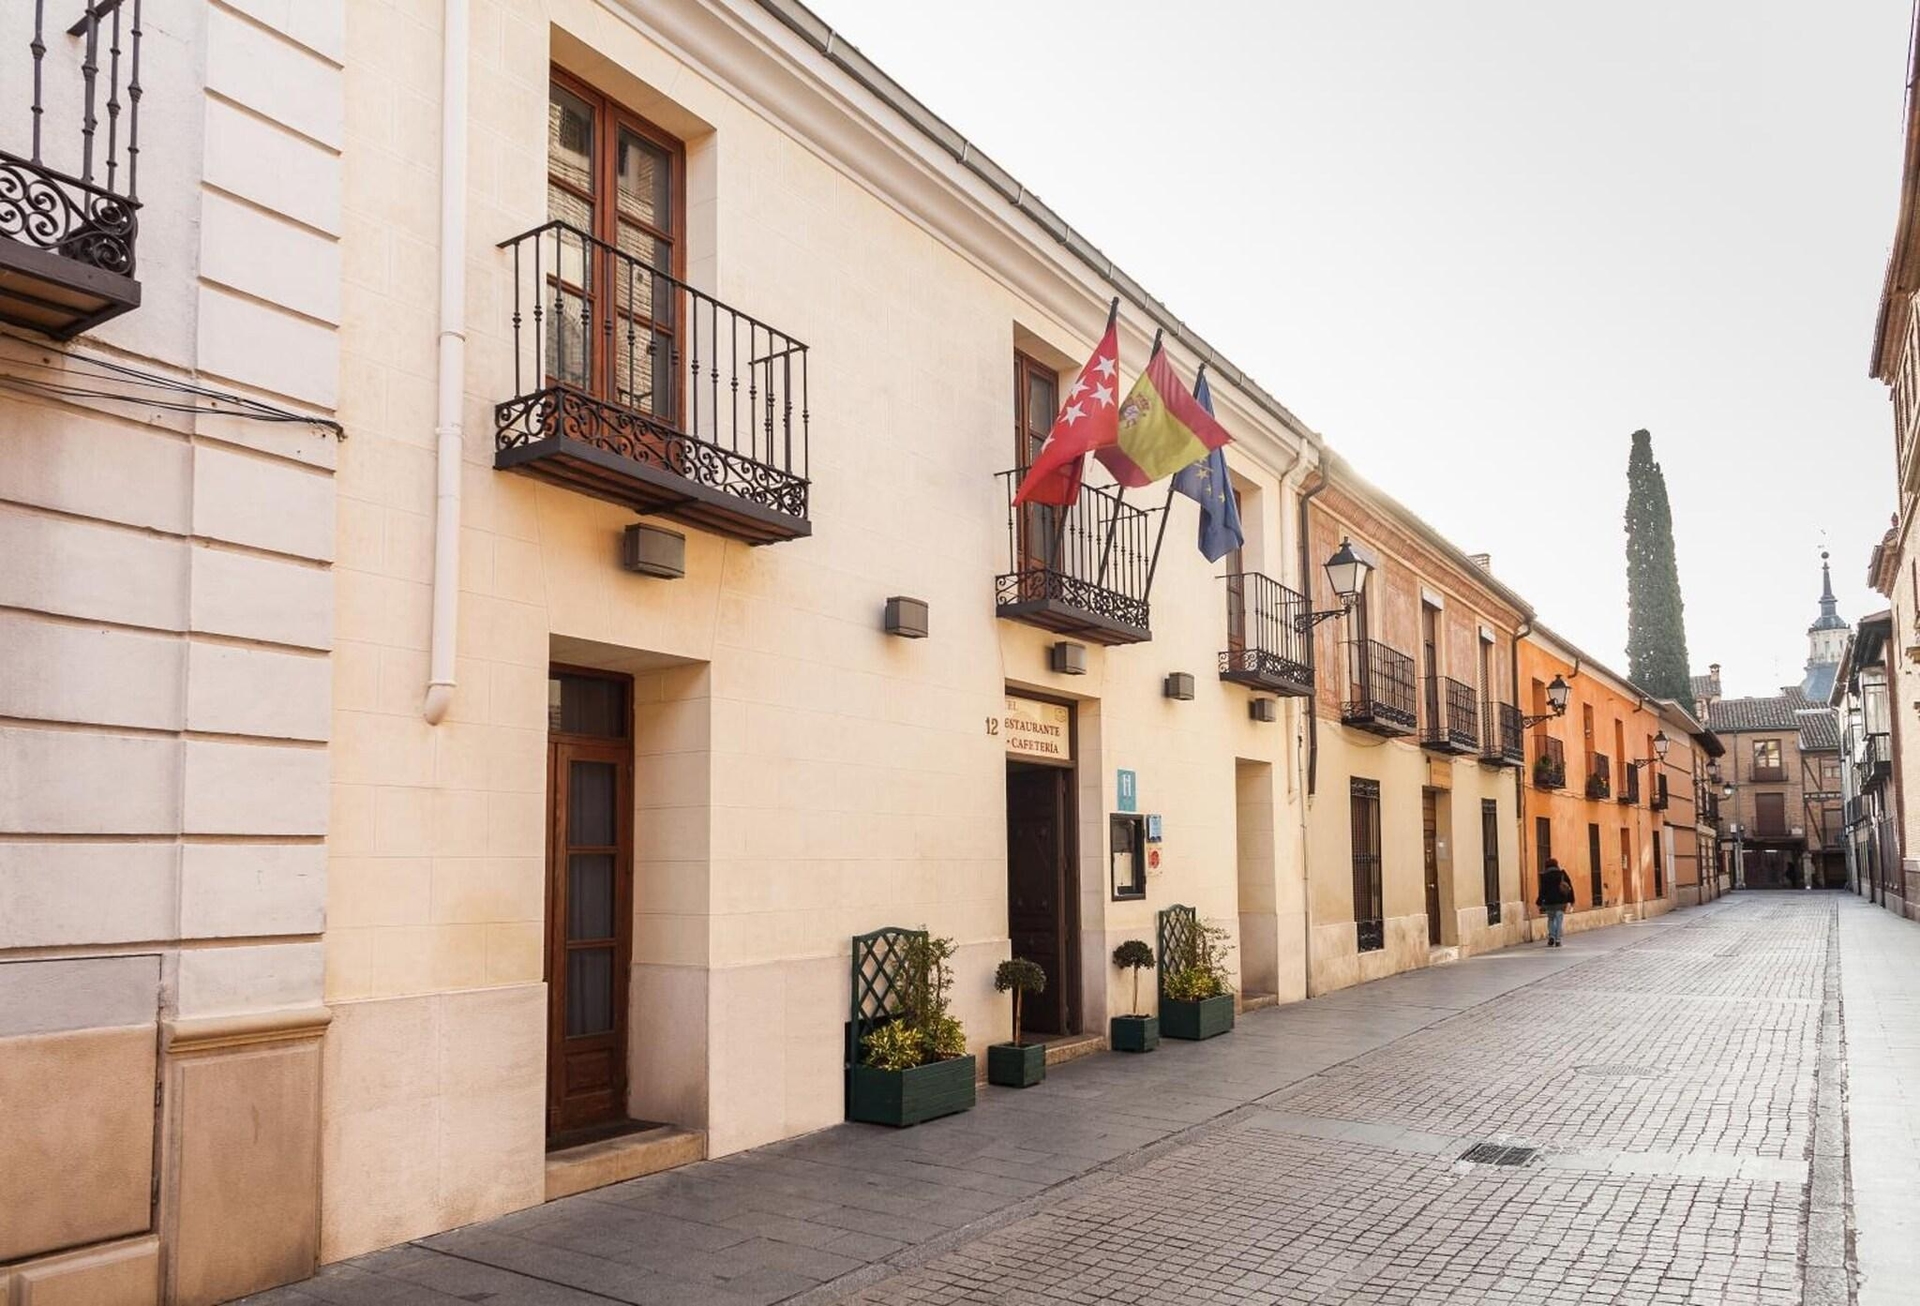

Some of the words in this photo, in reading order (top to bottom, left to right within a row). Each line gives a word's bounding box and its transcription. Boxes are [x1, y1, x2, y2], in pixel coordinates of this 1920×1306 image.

[985, 717, 999, 736] 12
[1005, 718, 1060, 737] ESTAURANTE
[1011, 737, 1059, 754] CAFETERÍA
